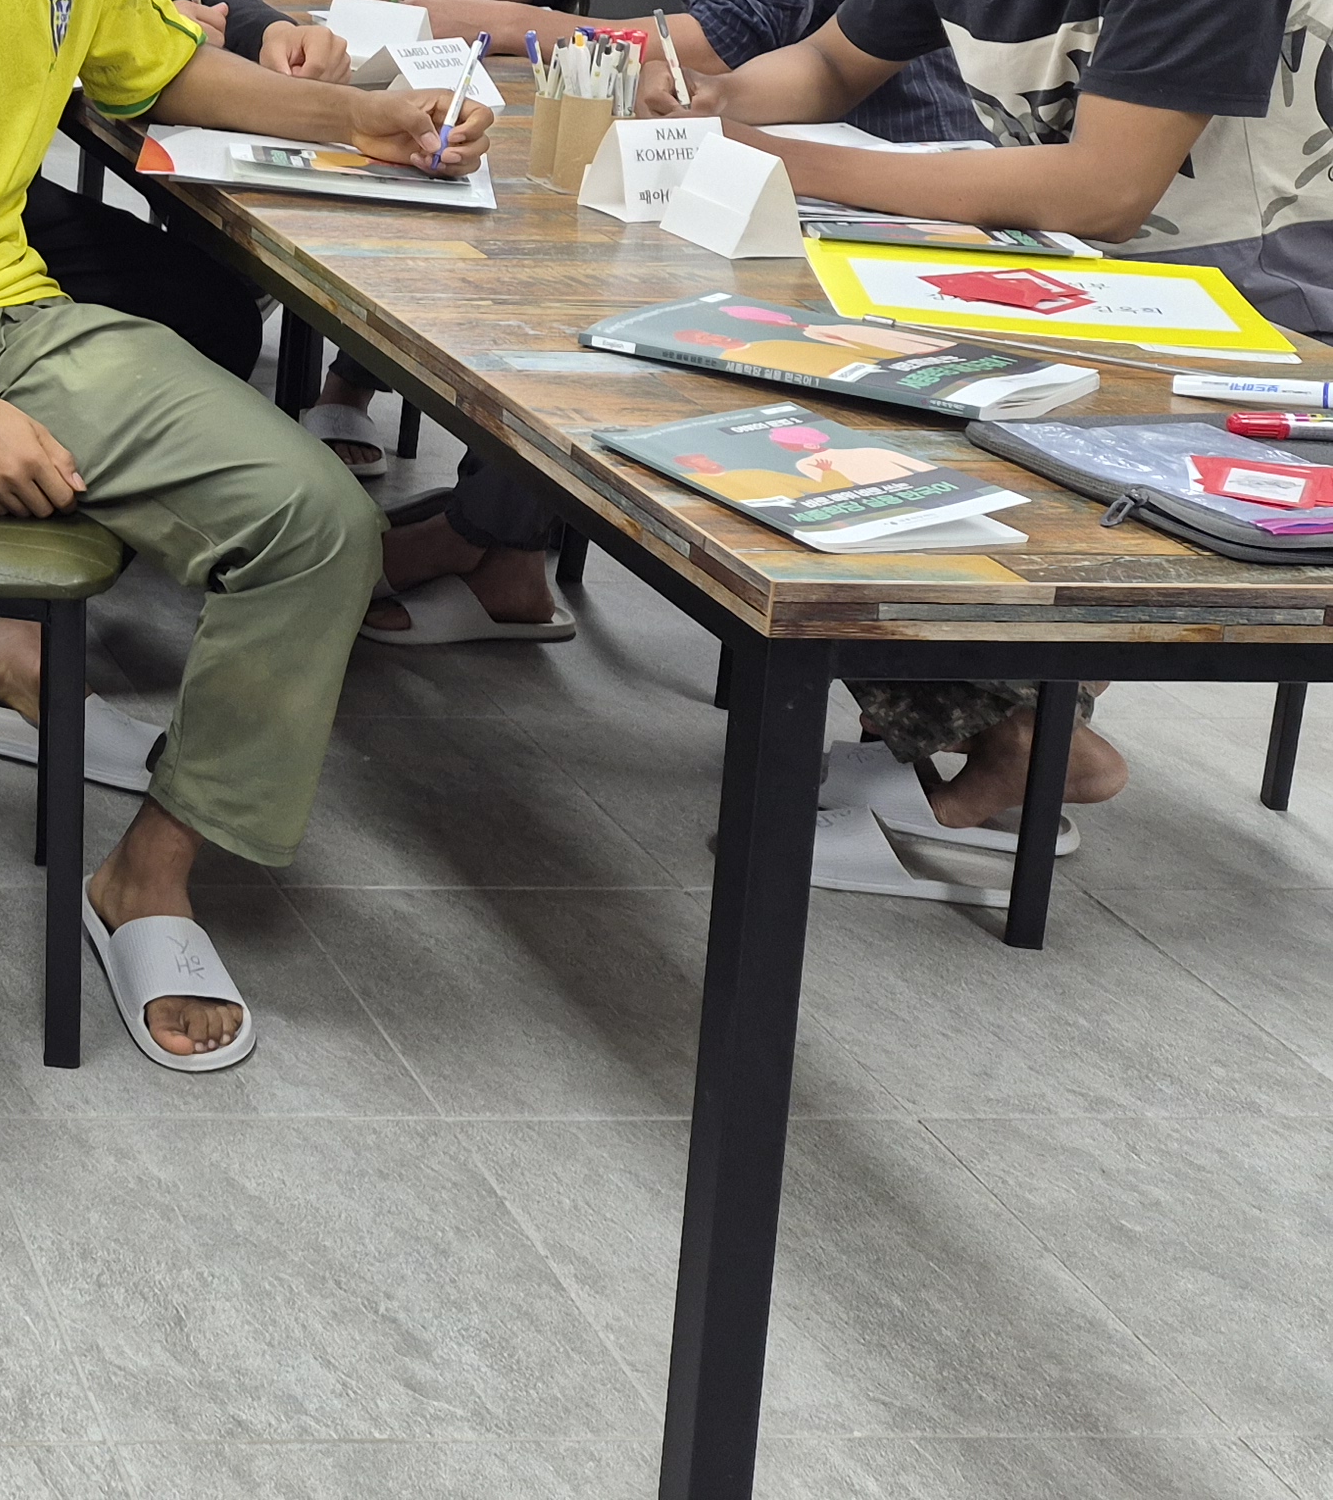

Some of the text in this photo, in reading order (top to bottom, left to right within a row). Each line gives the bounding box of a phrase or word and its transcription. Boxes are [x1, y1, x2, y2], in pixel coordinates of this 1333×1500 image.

[397, 43, 463, 58] LIMBU CHUN
[413, 57, 464, 70] BAHADUR
[655, 128, 687, 141] NAM
[635, 147, 699, 162] KOMPHE
